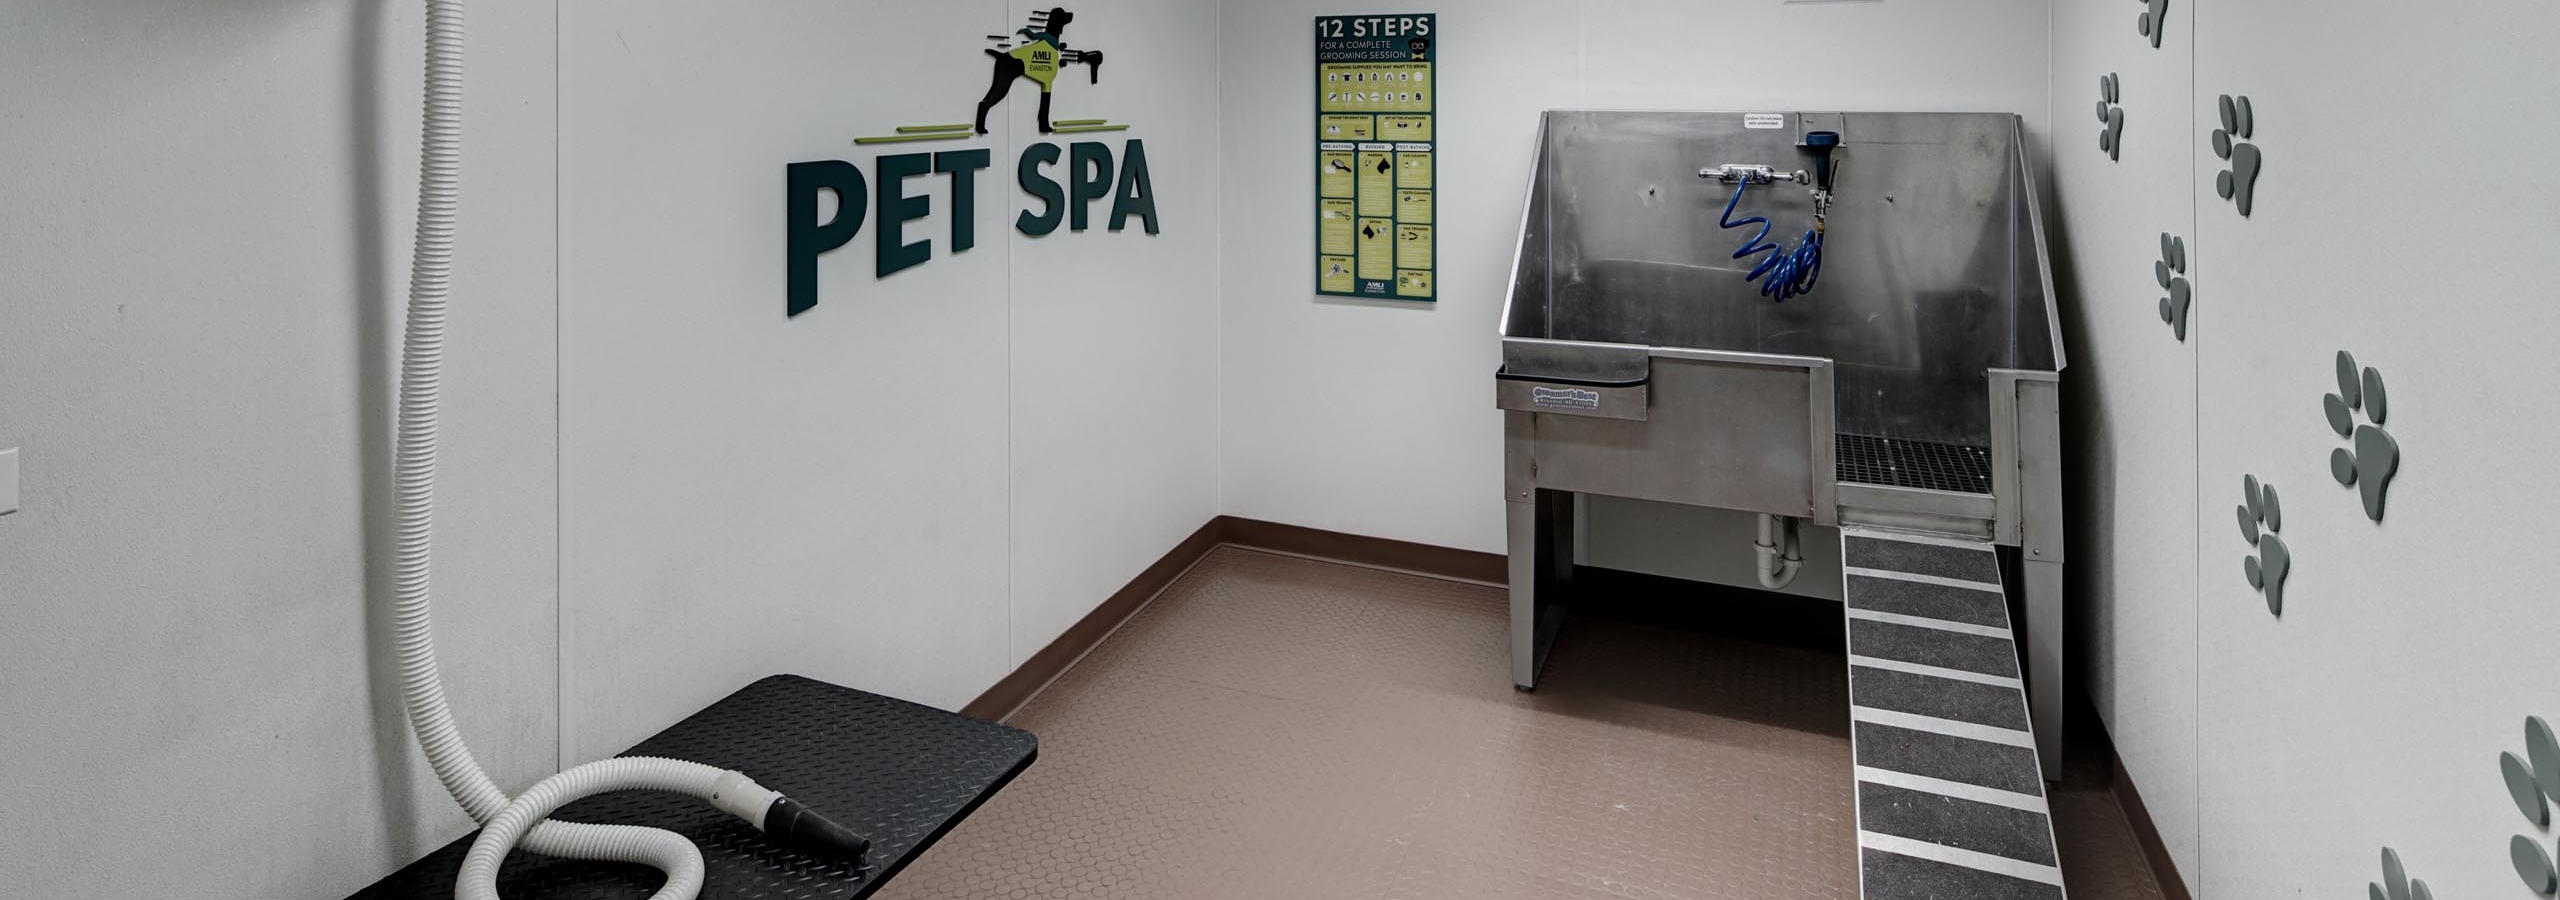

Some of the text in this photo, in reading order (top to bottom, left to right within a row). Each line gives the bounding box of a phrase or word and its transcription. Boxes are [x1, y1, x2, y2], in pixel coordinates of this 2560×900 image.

[1319, 17, 1430, 38] 12 STEPS
[1320, 40, 1391, 50] FOR A COMPLETE
[1032, 50, 1051, 60] AMLI
[1320, 51, 1407, 60] GROOMING SESSION
[1029, 64, 1052, 72] EVANSTON
[786, 139, 1159, 317] PET SPA
